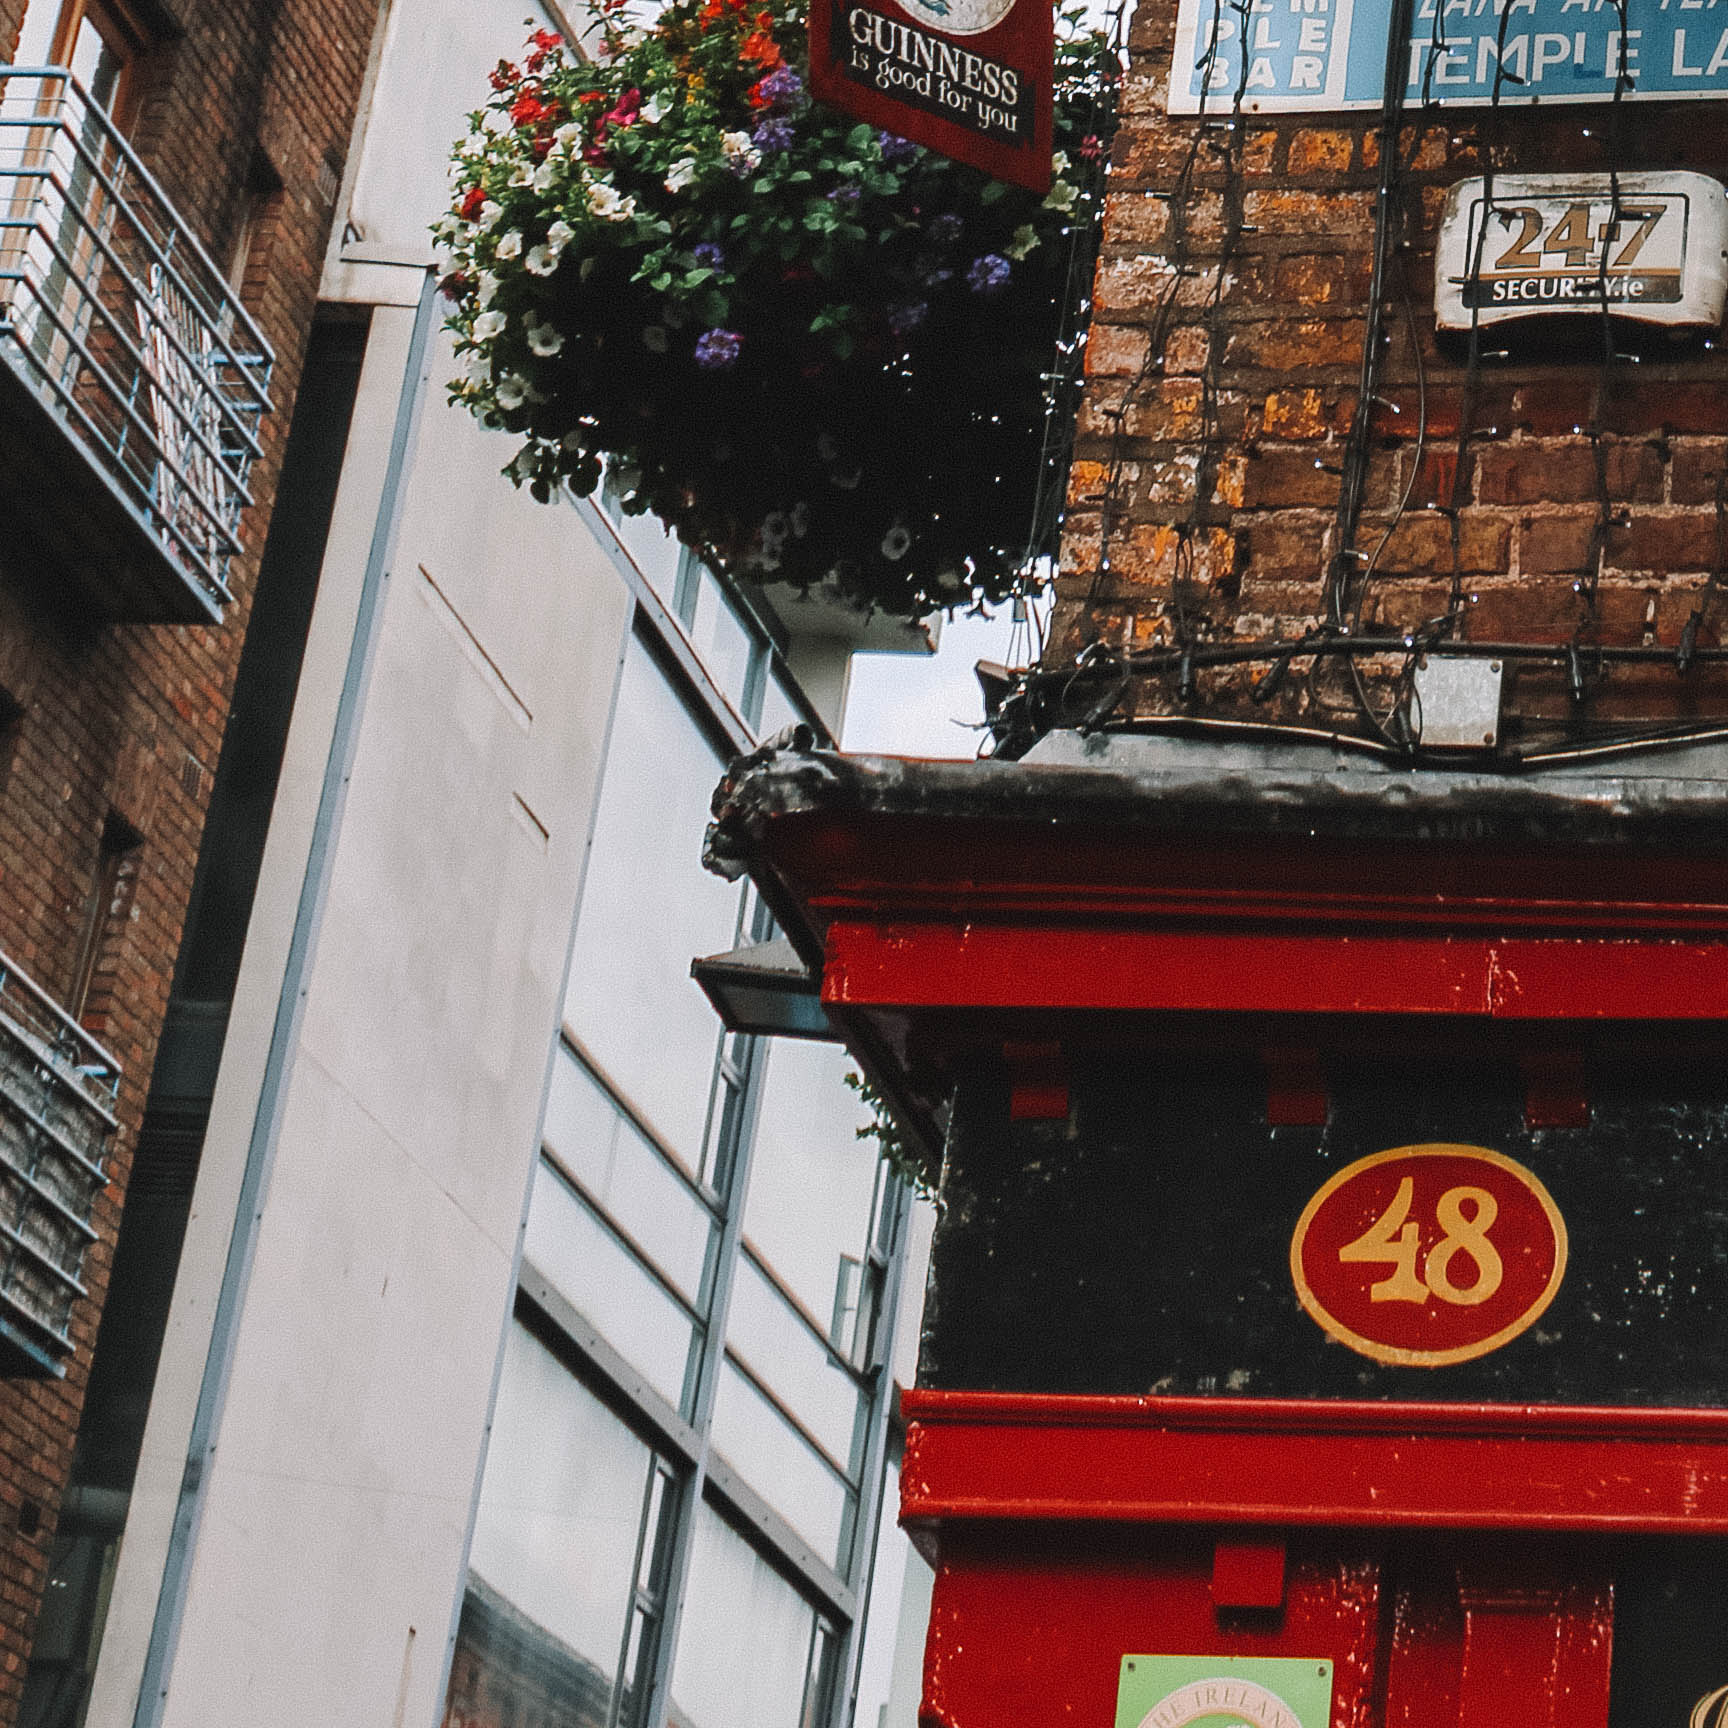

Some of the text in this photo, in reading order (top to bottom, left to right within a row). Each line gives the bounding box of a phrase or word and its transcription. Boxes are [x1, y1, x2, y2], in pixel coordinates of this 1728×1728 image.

[849, 7, 1019, 106] GUINNESS
[850, 44, 1019, 133] is good for you
[1494, 203, 1668, 270] 24-7
[1338, 1176, 1504, 1306] 48
